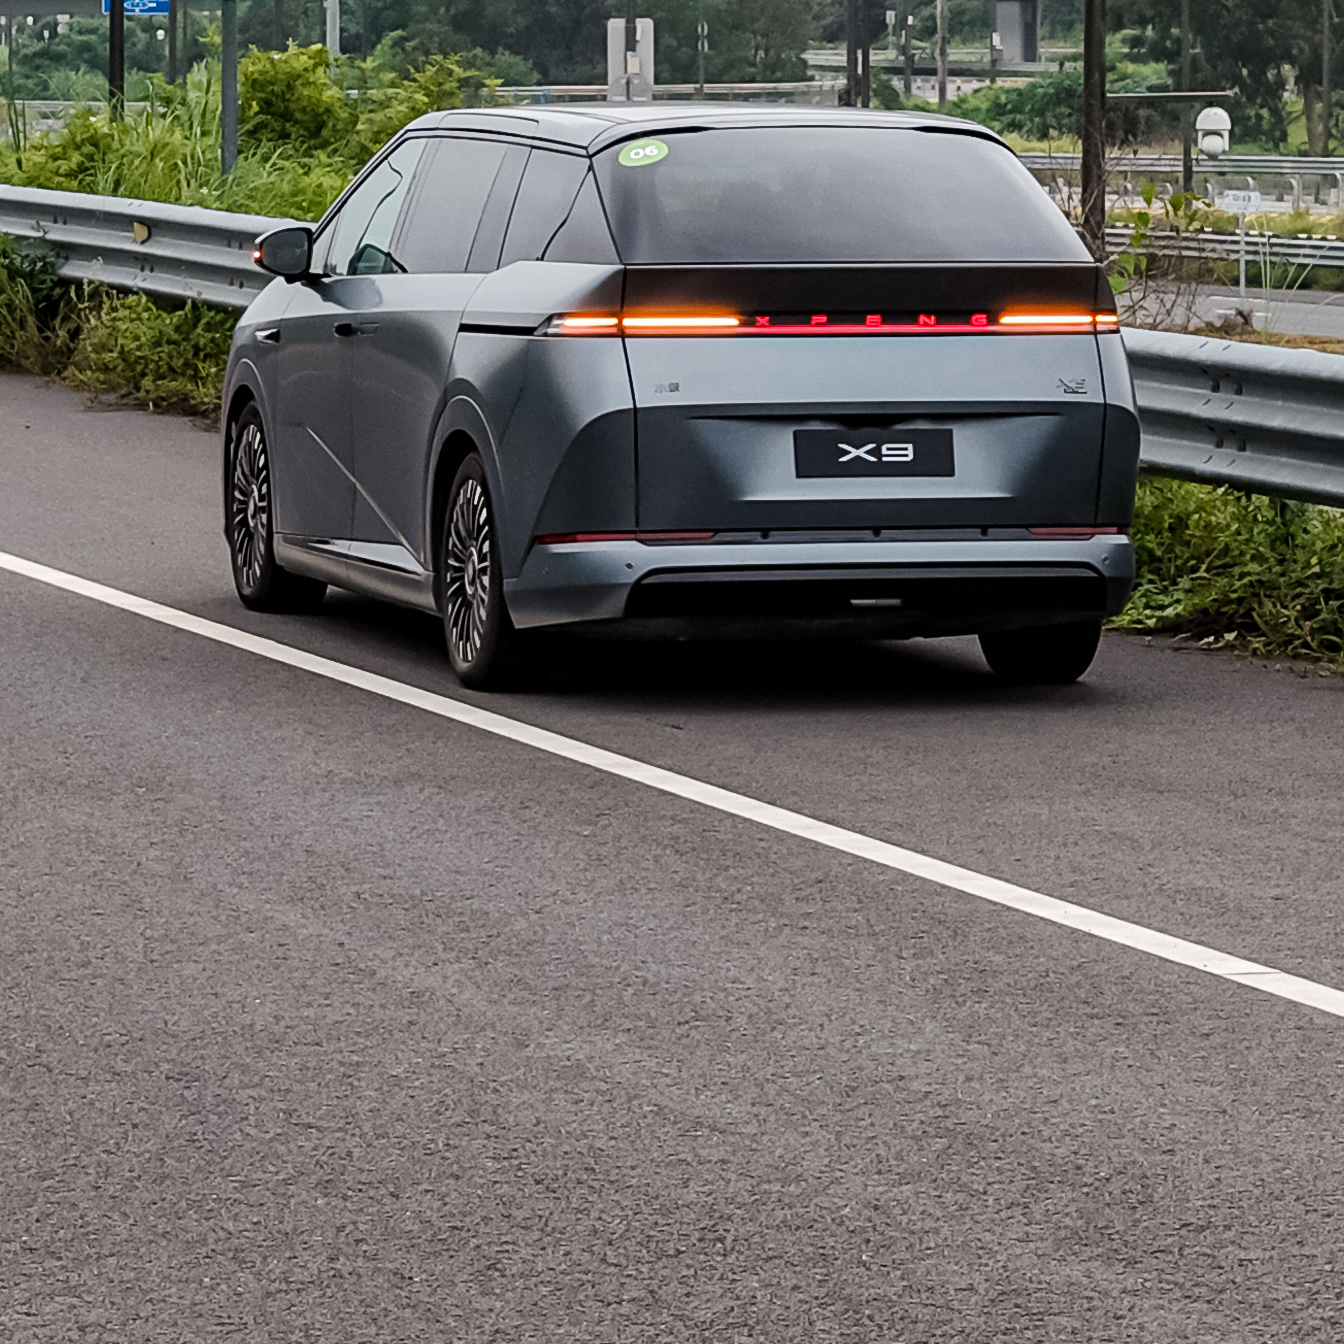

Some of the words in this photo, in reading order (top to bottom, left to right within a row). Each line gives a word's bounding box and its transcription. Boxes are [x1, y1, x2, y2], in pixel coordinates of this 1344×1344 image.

[629, 145, 659, 160] 06
[755, 313, 989, 327] XPENG
[837, 443, 914, 462] X9
